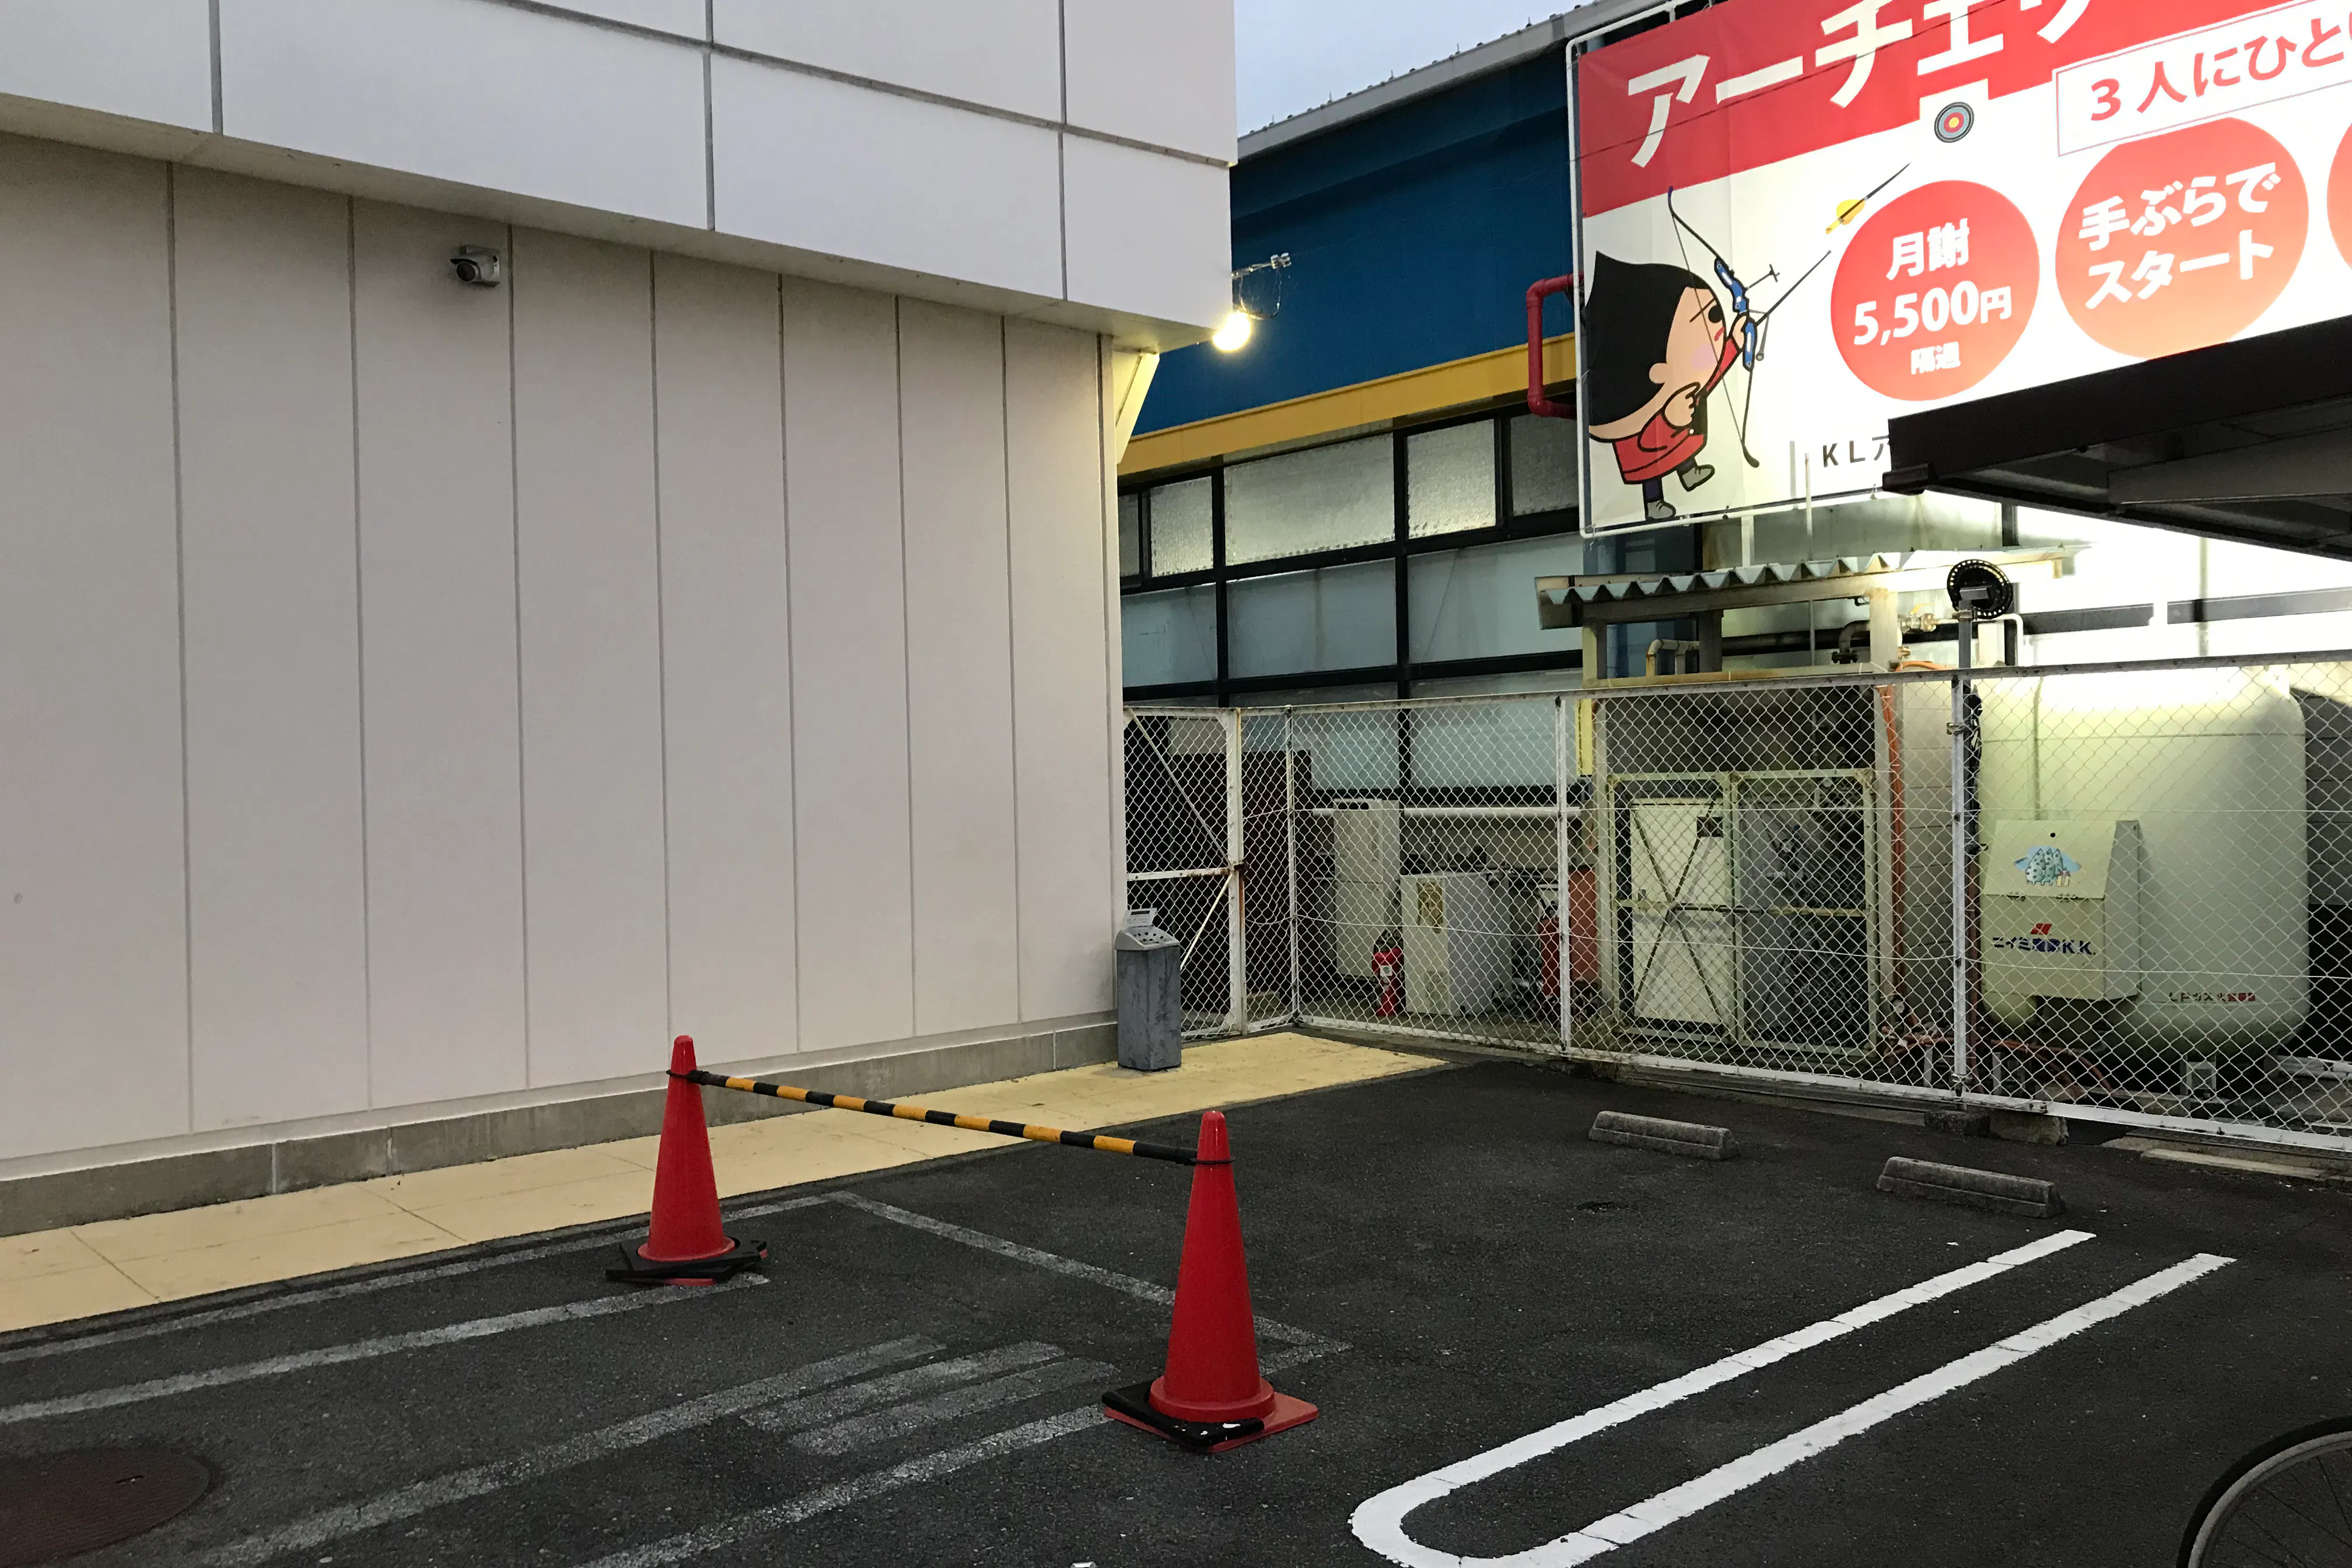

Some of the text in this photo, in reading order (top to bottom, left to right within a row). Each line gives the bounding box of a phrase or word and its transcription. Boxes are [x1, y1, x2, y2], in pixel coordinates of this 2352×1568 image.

[2091, 12, 2352, 121] 3人にひと
[2078, 162, 2281, 251] 手ぶらで
[2085, 229, 2274, 310] スタート
[1854, 280, 2012, 346] 5,500円
